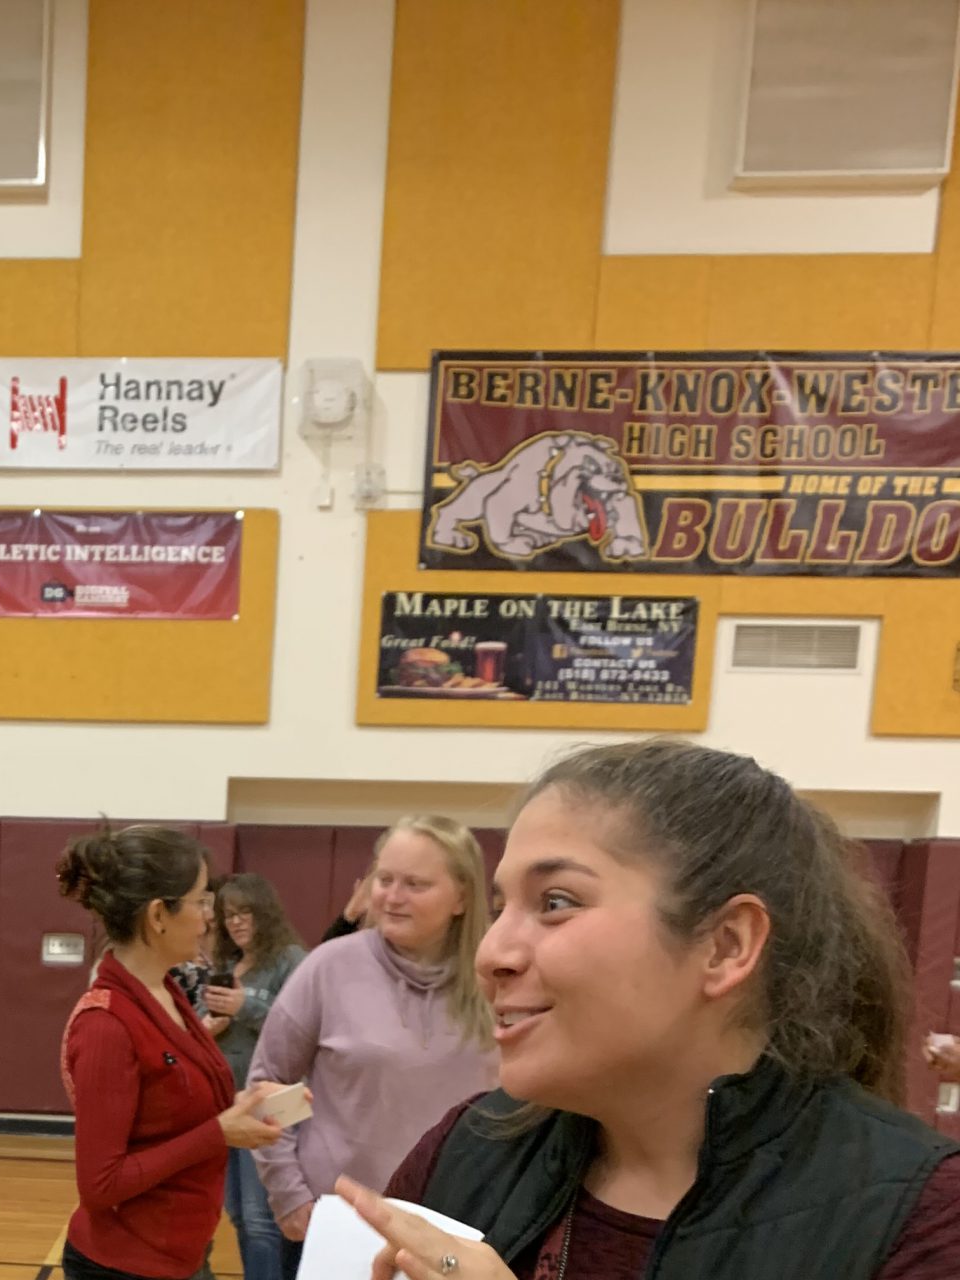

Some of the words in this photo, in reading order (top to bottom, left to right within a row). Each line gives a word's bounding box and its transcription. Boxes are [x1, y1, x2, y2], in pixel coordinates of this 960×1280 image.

[98, 371, 227, 408] Hannay
[98, 405, 189, 434] Reels
[96, 440, 126, 456] The
[623, 421, 718, 461] HIGH
[730, 423, 887, 462] SCHOOL
[789, 474, 851, 496] HOME
[856, 475, 888, 497] OF
[893, 475, 939, 497] THE
[65, 543, 226, 563] INTELLIGENCE
[394, 592, 489, 618] MAPLE
[499, 599, 538, 618] ON
[547, 600, 600, 620] THE
[610, 596, 685, 620] LAKE
[381, 635, 426, 649] Great
[429, 635, 477, 649] Fod!
[579, 635, 633, 647] FOLLOW
[635, 636, 655, 647] US
[573, 658, 635, 669] CONTACT
[638, 659, 658, 670] US
